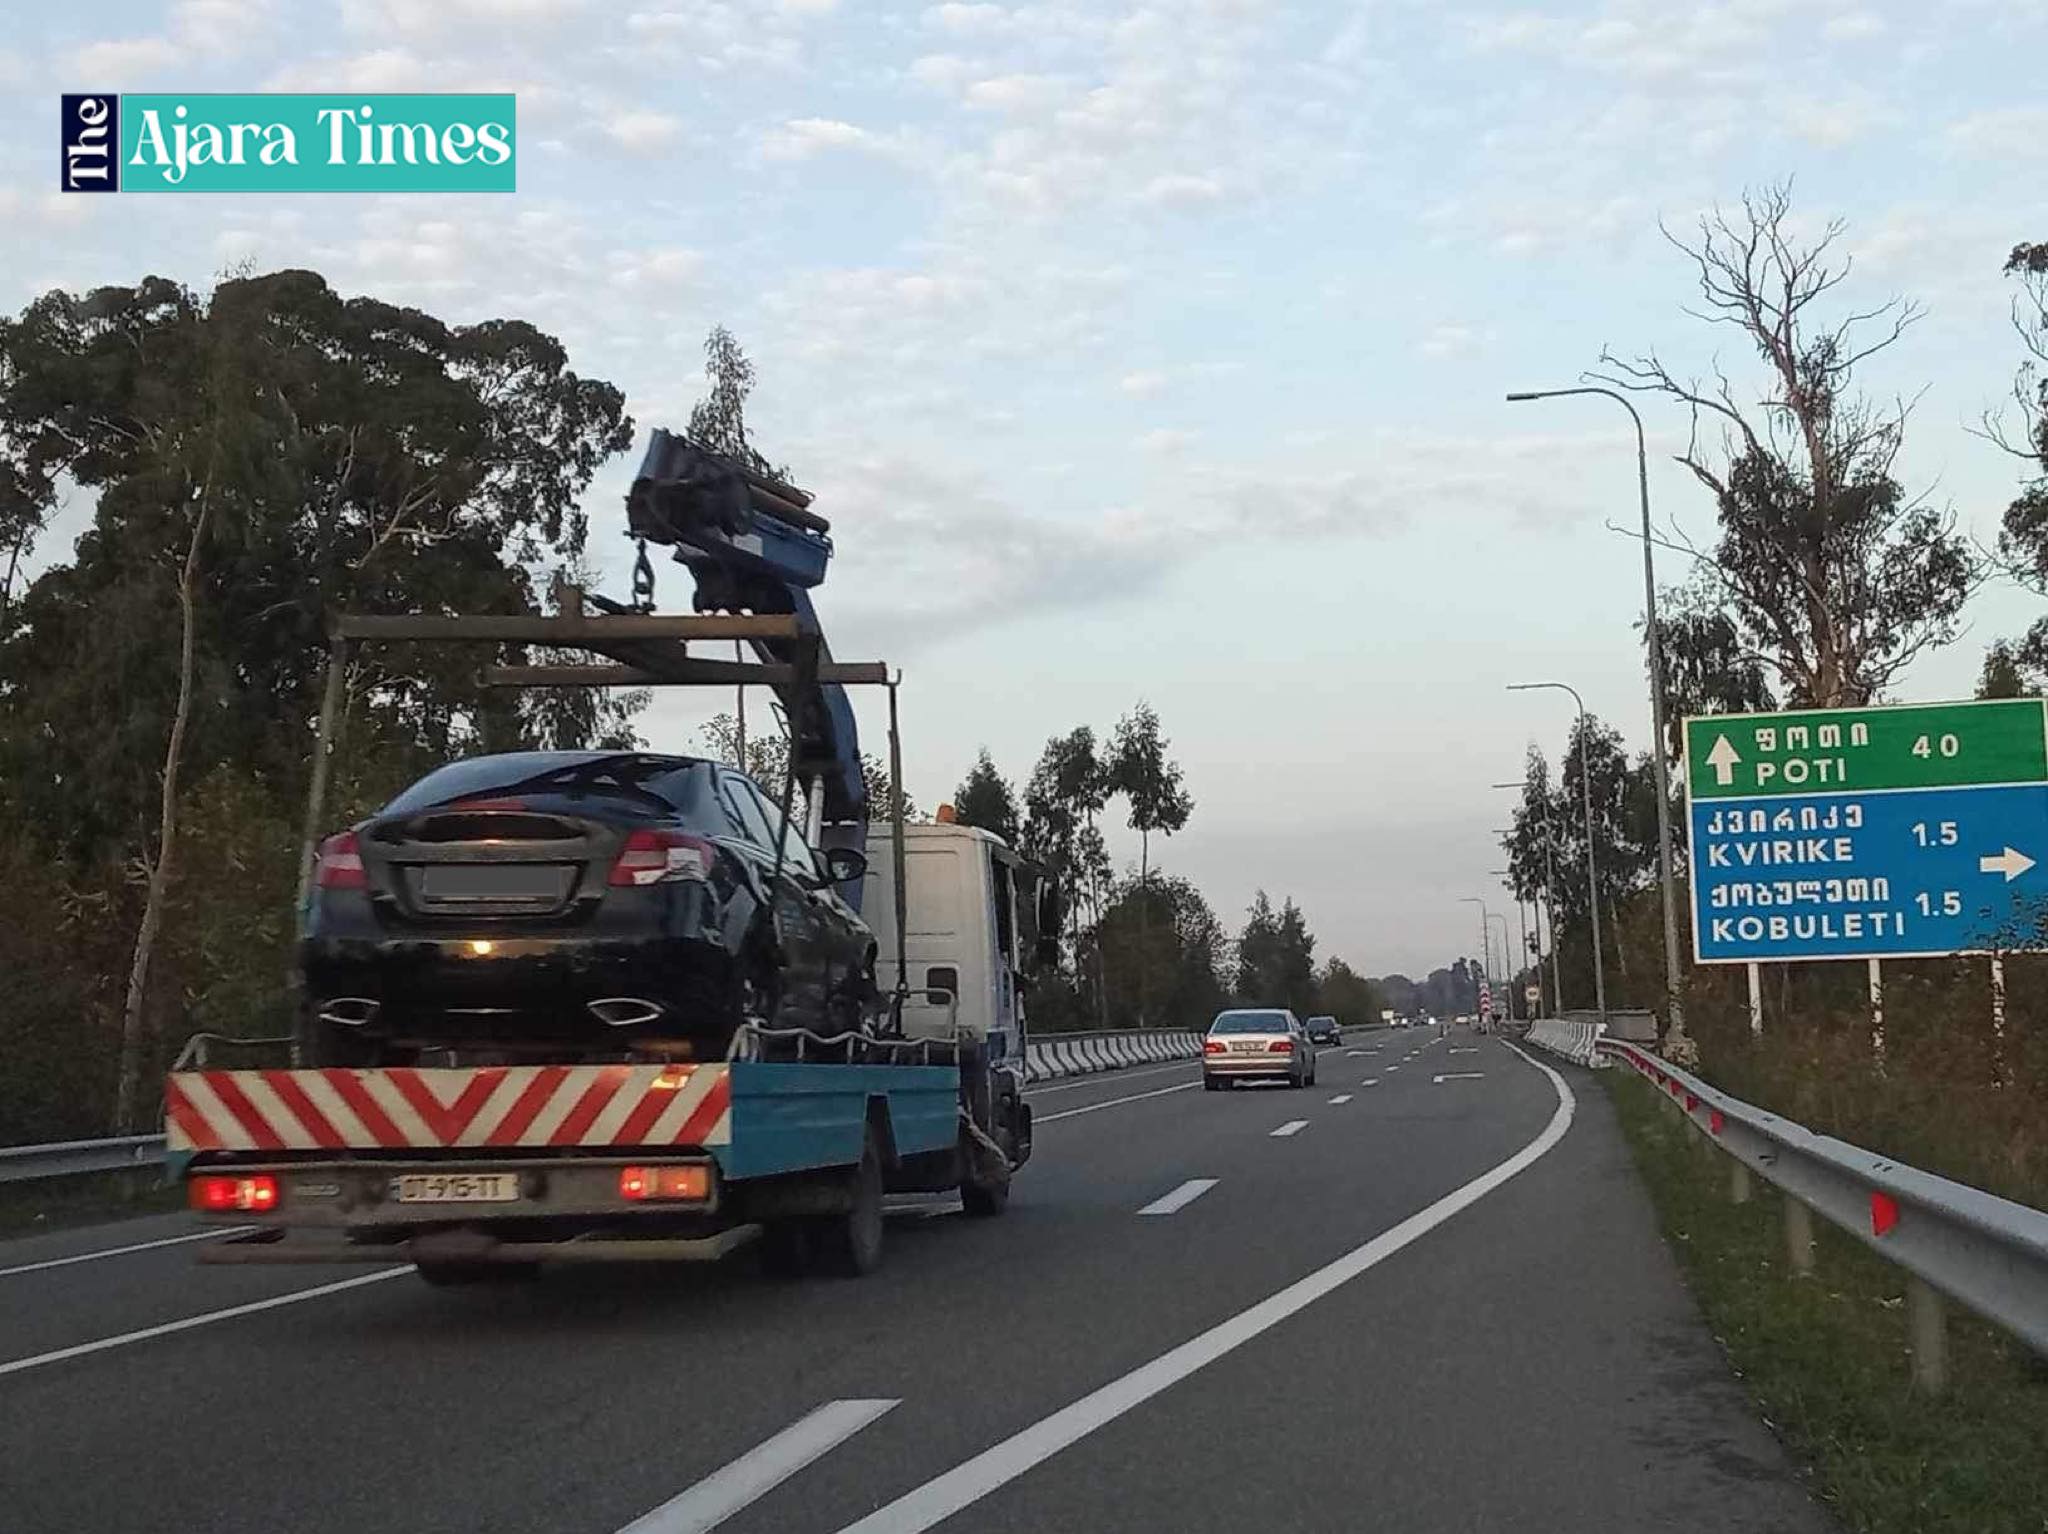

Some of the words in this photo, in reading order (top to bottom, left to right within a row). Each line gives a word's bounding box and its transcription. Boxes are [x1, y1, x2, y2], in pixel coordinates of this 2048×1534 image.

[1755, 722, 1868, 751] ფოთი
[1912, 734, 1959, 760] 40
[1757, 758, 1846, 787] POTI
[1707, 804, 1863, 834] კვირიკე
[1912, 822, 1959, 846] 1.5
[1708, 837, 1854, 867] KVIRIKE
[1711, 877, 1890, 907] ქობულეთი
[1914, 893, 1963, 917] 1.5
[1712, 912, 1905, 943] KOBULETI
